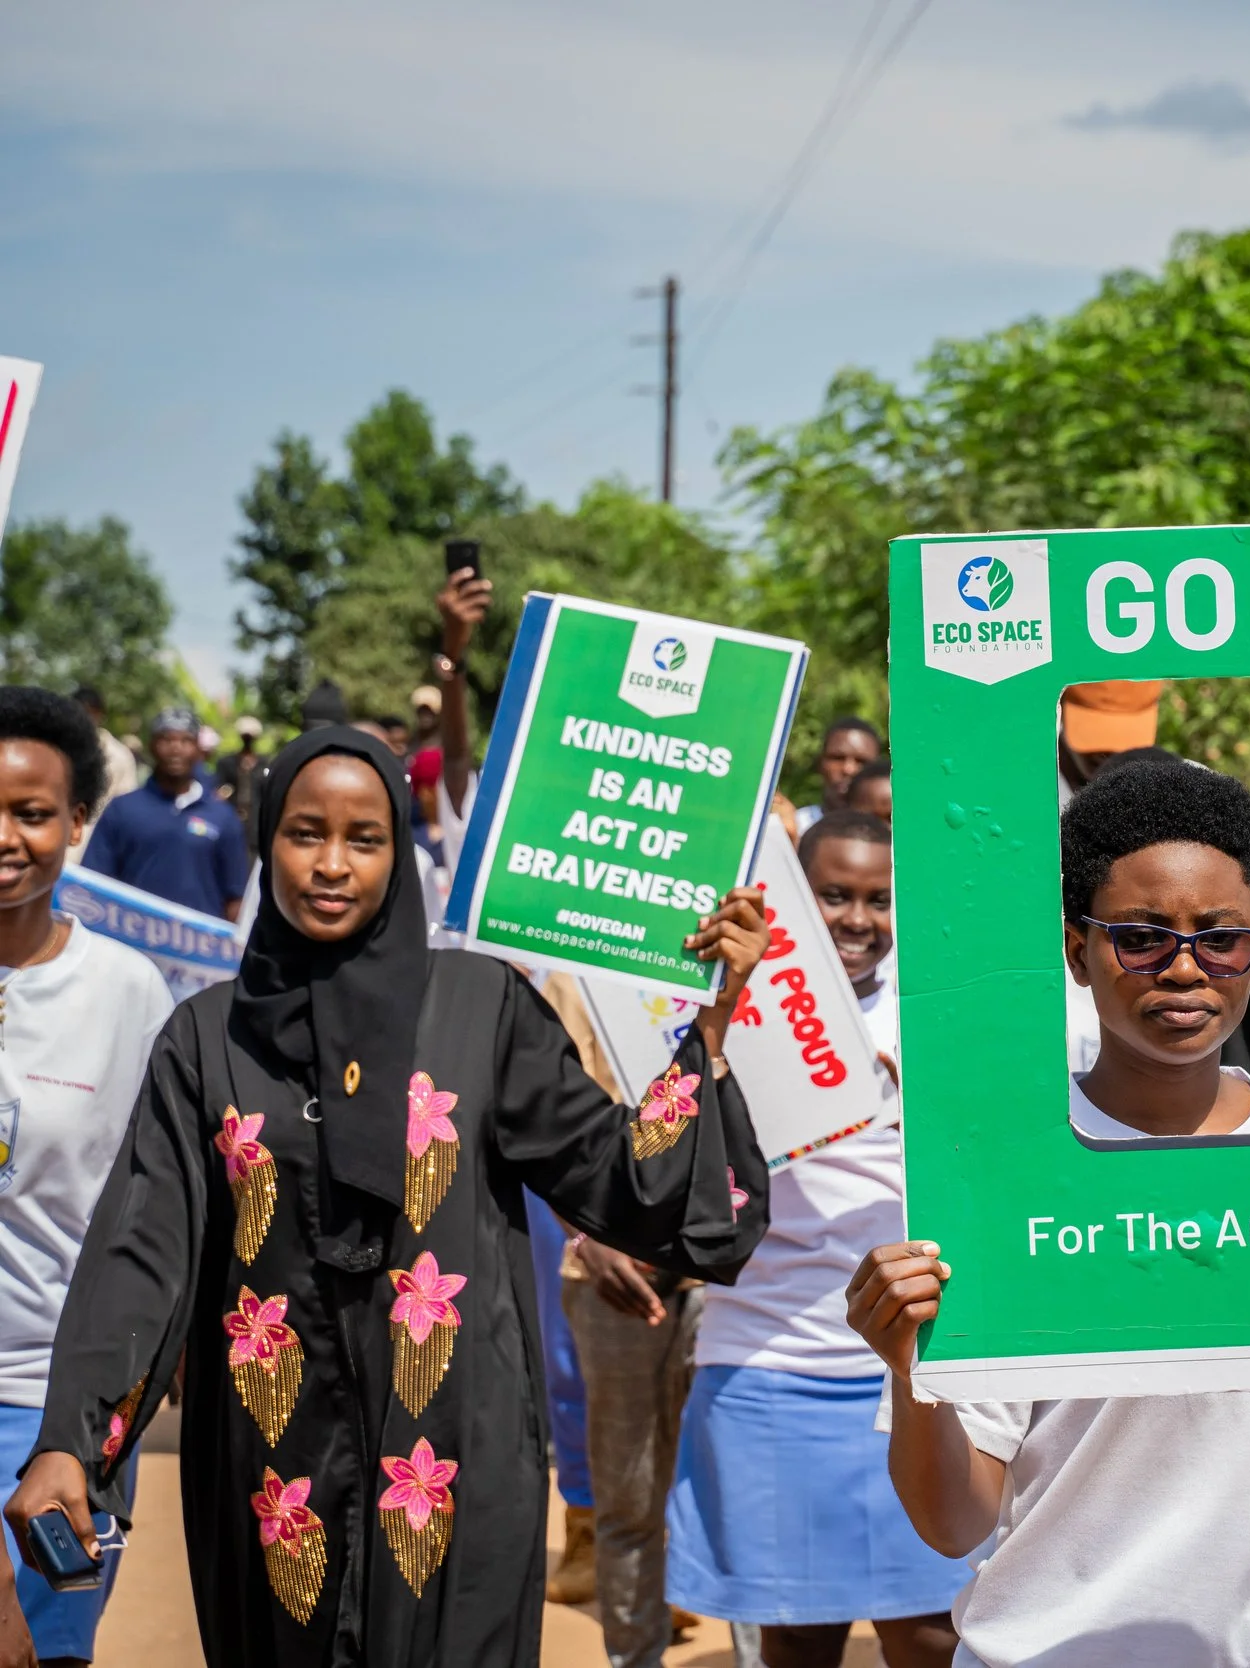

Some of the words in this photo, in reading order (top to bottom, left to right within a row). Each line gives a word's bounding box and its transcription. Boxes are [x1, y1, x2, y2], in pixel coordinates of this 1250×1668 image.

[1086, 557, 1236, 654] GO
[933, 622, 972, 645] ECO
[977, 619, 1043, 643] SPACE
[933, 642, 1043, 654] FOUNDATION
[628, 672, 653, 688] ECO
[656, 678, 697, 697] SPACE
[560, 715, 732, 778] KINDNESS
[587, 767, 625, 802] IS
[626, 777, 684, 815] AN
[561, 809, 638, 850] ACT
[638, 826, 689, 861] OF
[507, 843, 718, 915] BRAVENESS
[486, 916, 706, 978] www.ecospacefoundation.org
[556, 908, 647, 942] #GOVEGAN
[769, 966, 848, 1088] PROUD
[1028, 1216, 1104, 1256] For
[1116, 1212, 1201, 1252] The
